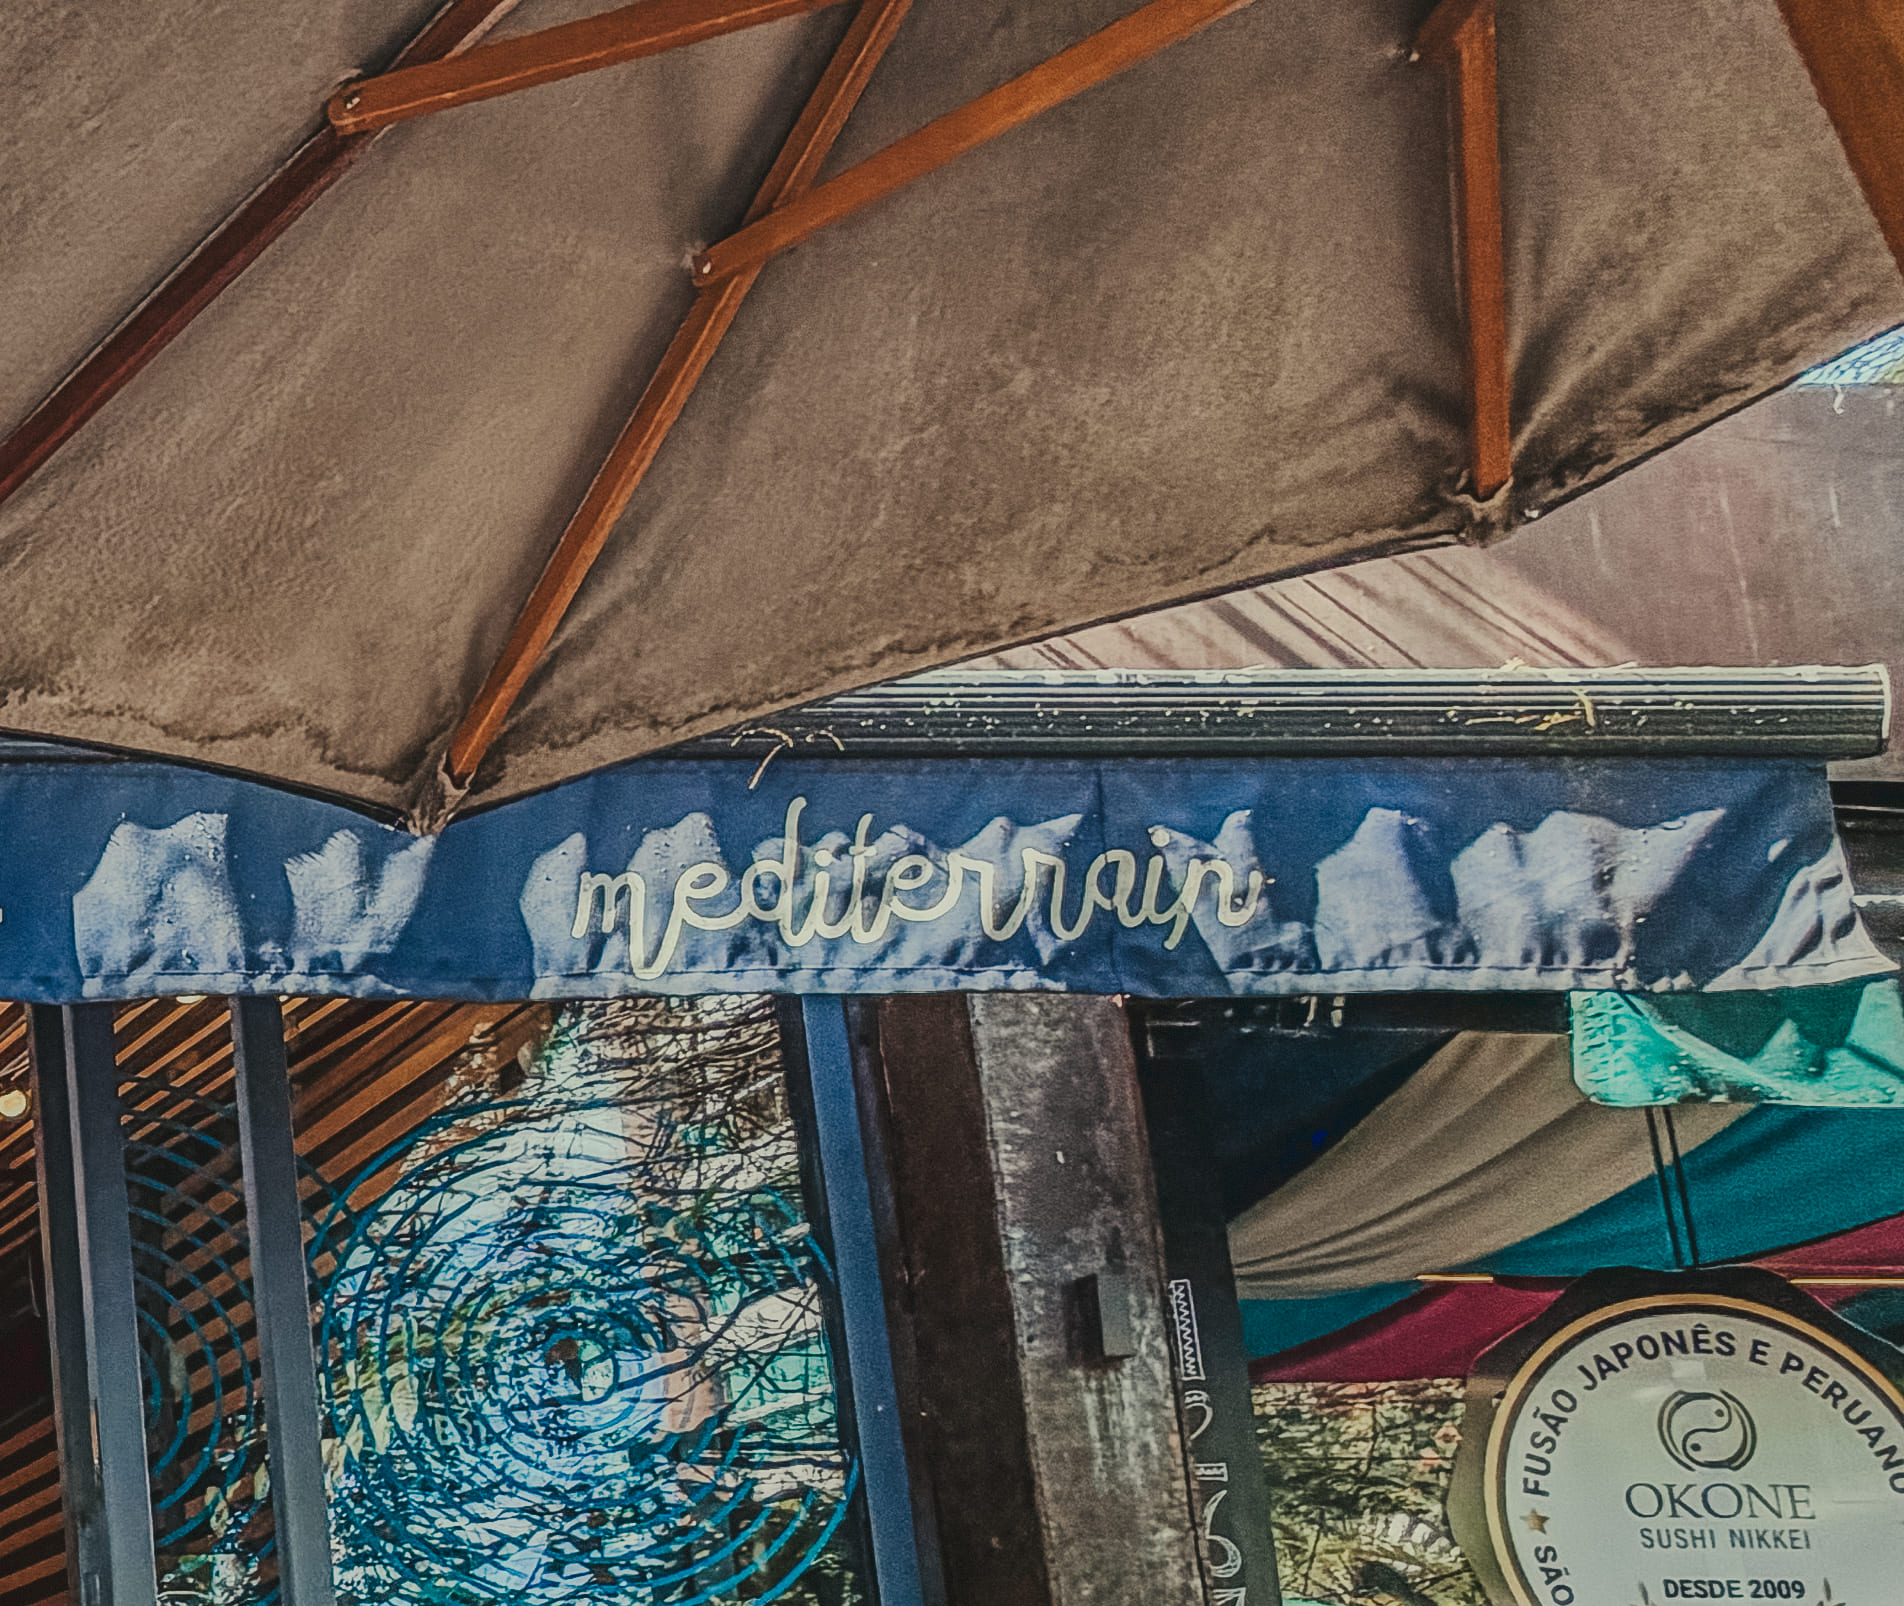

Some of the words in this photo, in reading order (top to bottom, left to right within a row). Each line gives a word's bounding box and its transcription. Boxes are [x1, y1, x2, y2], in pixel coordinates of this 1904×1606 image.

[571, 797, 1264, 980] mediterrain
[1522, 1388, 1578, 1497] FUSÃO
[1577, 1322, 1736, 1391] JAPONÊS
[1748, 1338, 1772, 1366] E
[1625, 1482, 1817, 1520] OKONE
[1639, 1527, 1717, 1549] SUSHI
[1728, 1528, 1812, 1550] NIKKEI
[1534, 1545, 1574, 1606] SÃO
[1663, 1578, 1745, 1599] DESDE
[1747, 1579, 1806, 1600] 2009
